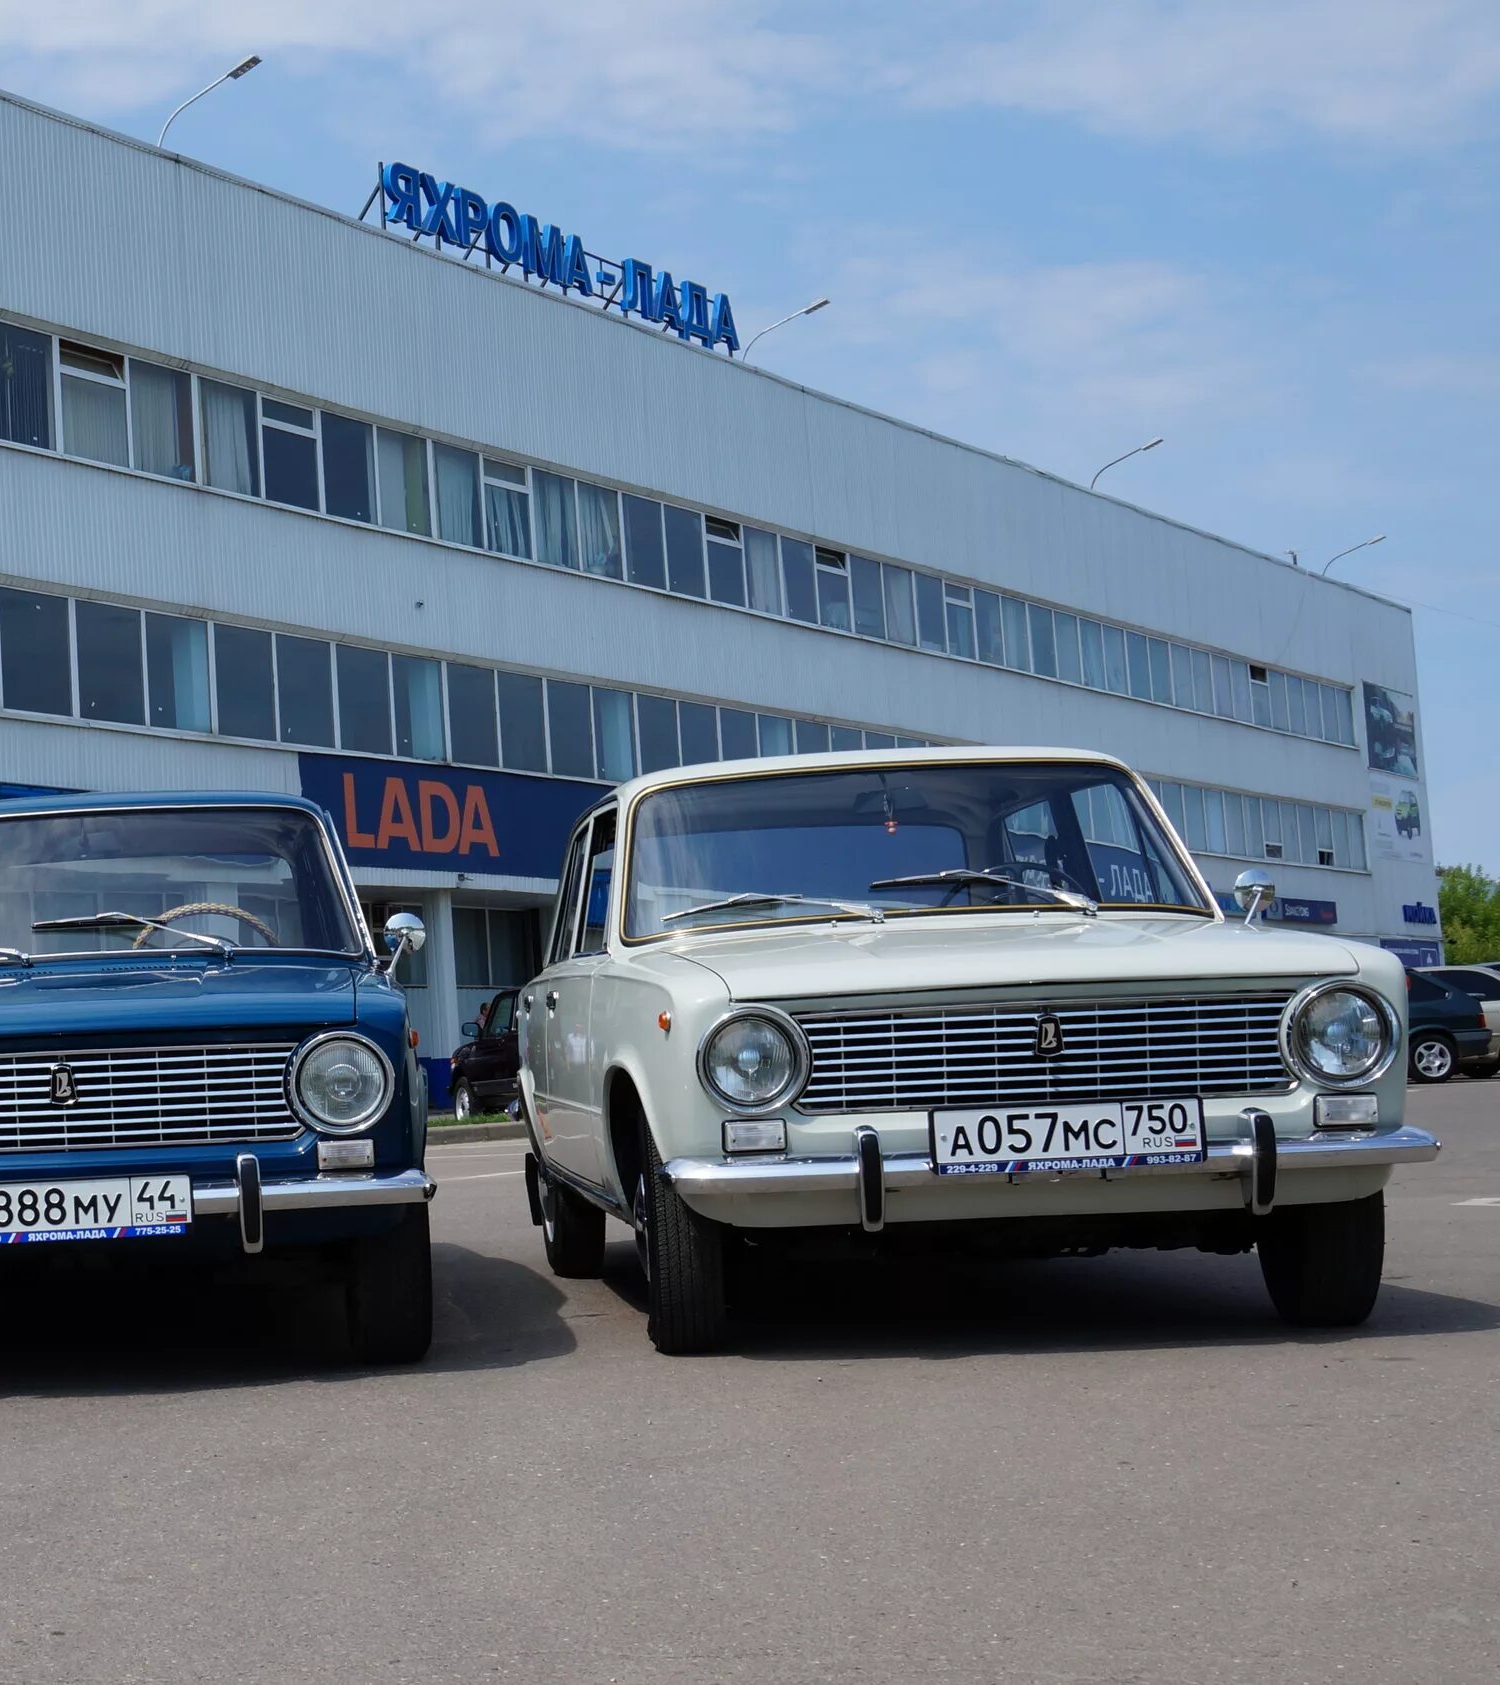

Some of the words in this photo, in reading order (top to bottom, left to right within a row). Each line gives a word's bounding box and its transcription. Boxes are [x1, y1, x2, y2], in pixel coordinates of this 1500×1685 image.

[384, 162, 740, 350] ЯХРОМА-ЛАДА
[343, 772, 500, 857] LADA
[1110, 864, 1156, 904] ЛАДА
[950, 1111, 1118, 1157] А057МС
[1124, 1102, 1188, 1136] 750
[1142, 1136, 1173, 1148] RUS
[946, 1163, 998, 1174] 229-4-229
[1027, 1157, 1116, 1170] ЯХРОМА-ЛАДА
[1146, 1153, 1197, 1165] 993-82-87
[136, 1180, 176, 1211] 44
[134, 1211, 164, 1223] RUS
[27, 1229, 107, 1242] ЯХРОМА-ЛАДА
[135, 1225, 182, 1236] 775-25-25
